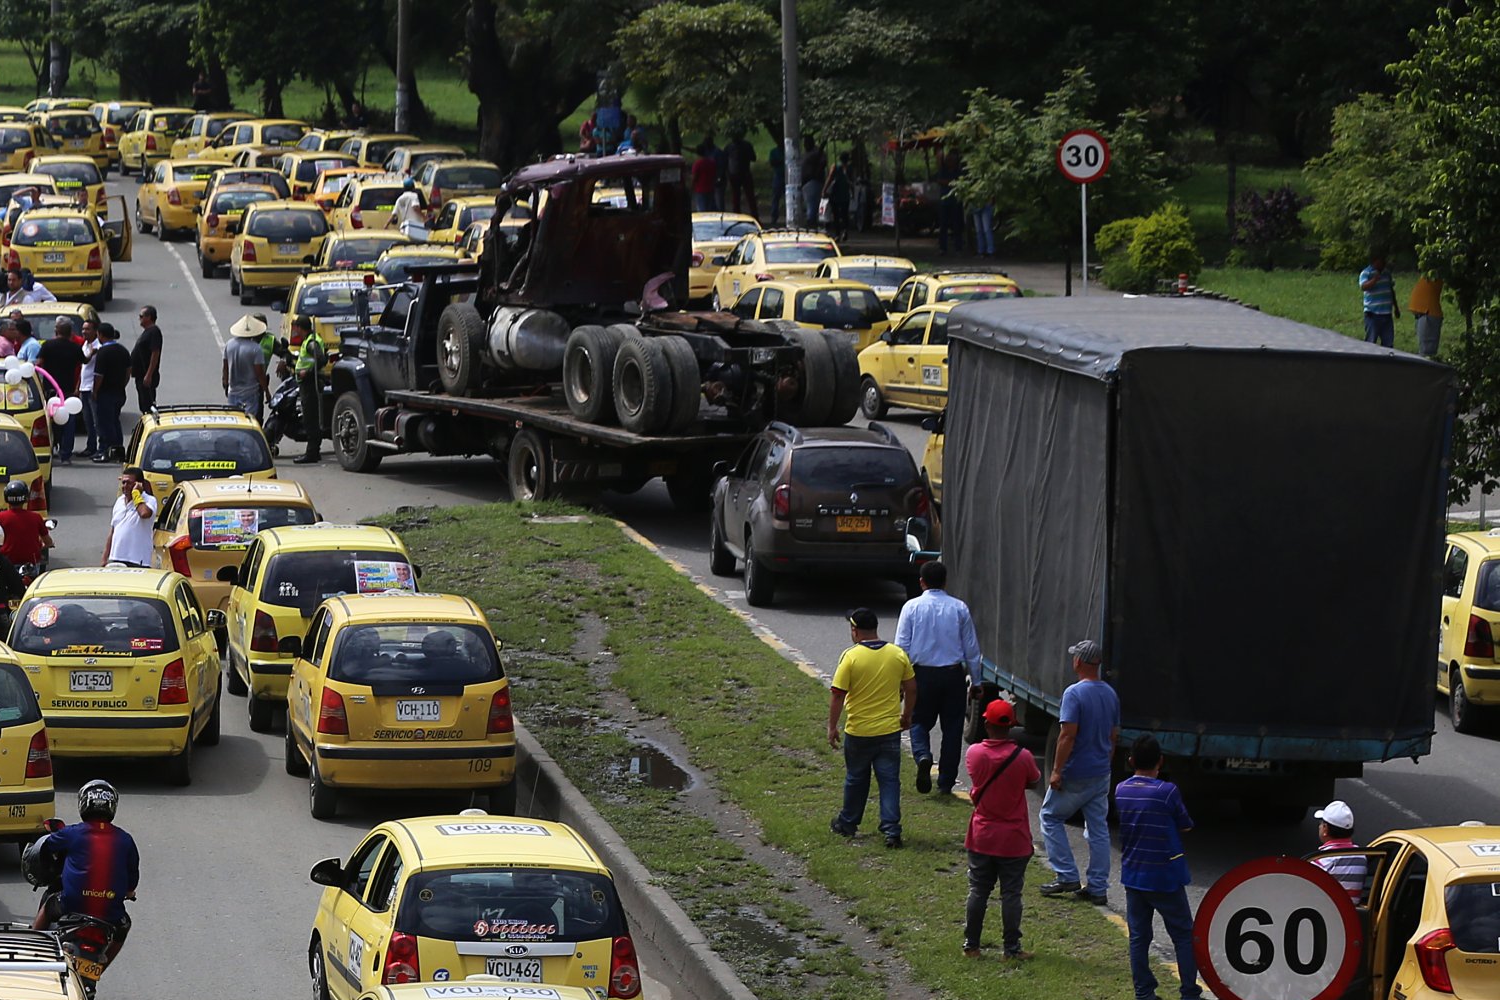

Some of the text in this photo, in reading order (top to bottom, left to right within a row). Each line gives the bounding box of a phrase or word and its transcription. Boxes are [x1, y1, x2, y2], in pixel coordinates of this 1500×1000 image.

[1066, 145, 1099, 168] 30
[51, 700, 128, 708] SERVICIO PUBLICO
[373, 729, 463, 739] SERVICIO PUBLICO
[468, 758, 492, 773] 109
[8, 805, 26, 818] 14793
[1224, 907, 1328, 976] 60
[509, 946, 524, 954] KIA
